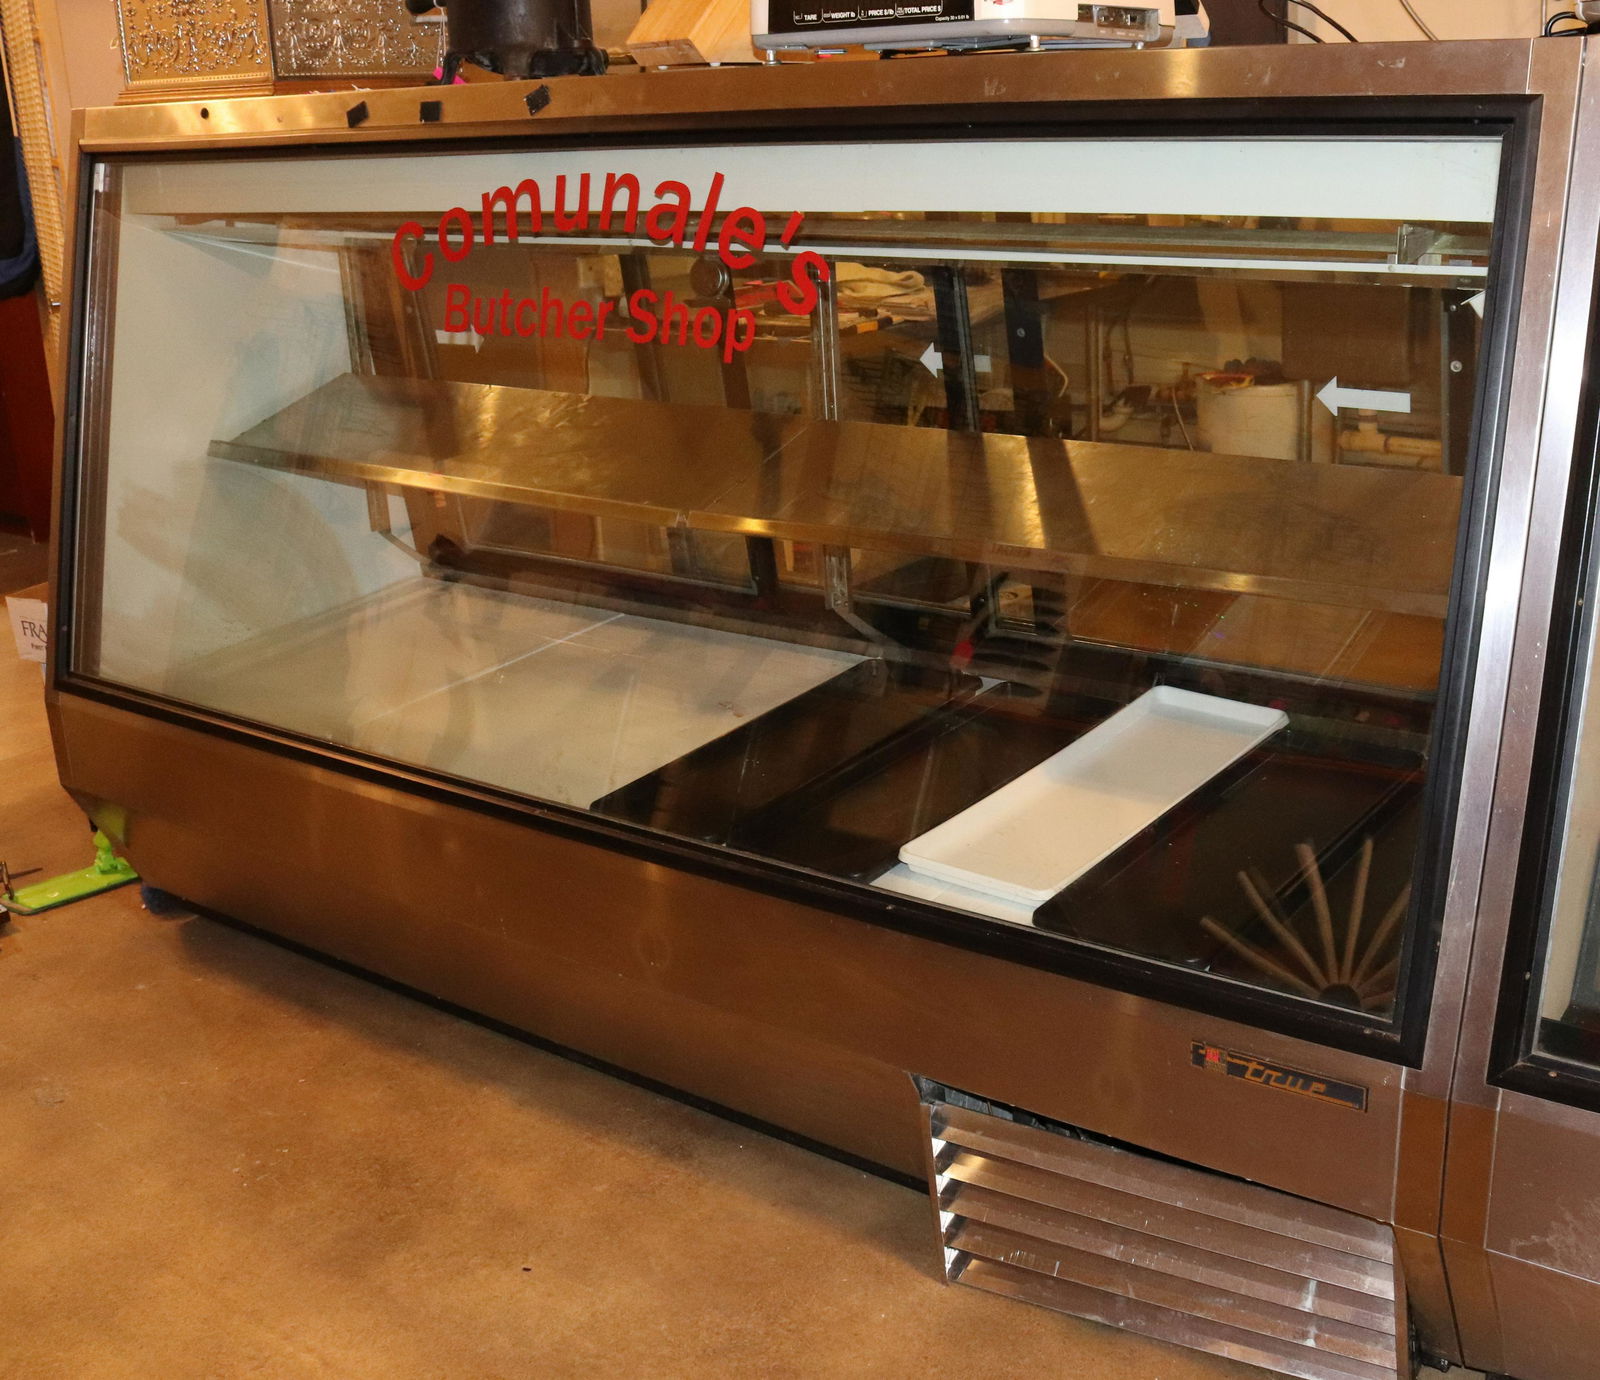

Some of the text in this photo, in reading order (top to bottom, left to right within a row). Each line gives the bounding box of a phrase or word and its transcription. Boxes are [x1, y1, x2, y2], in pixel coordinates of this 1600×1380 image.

[391, 172, 831, 316] Comunale's
[443, 283, 757, 364] Butcher Shop
[1234, 1059, 1328, 1096] true
